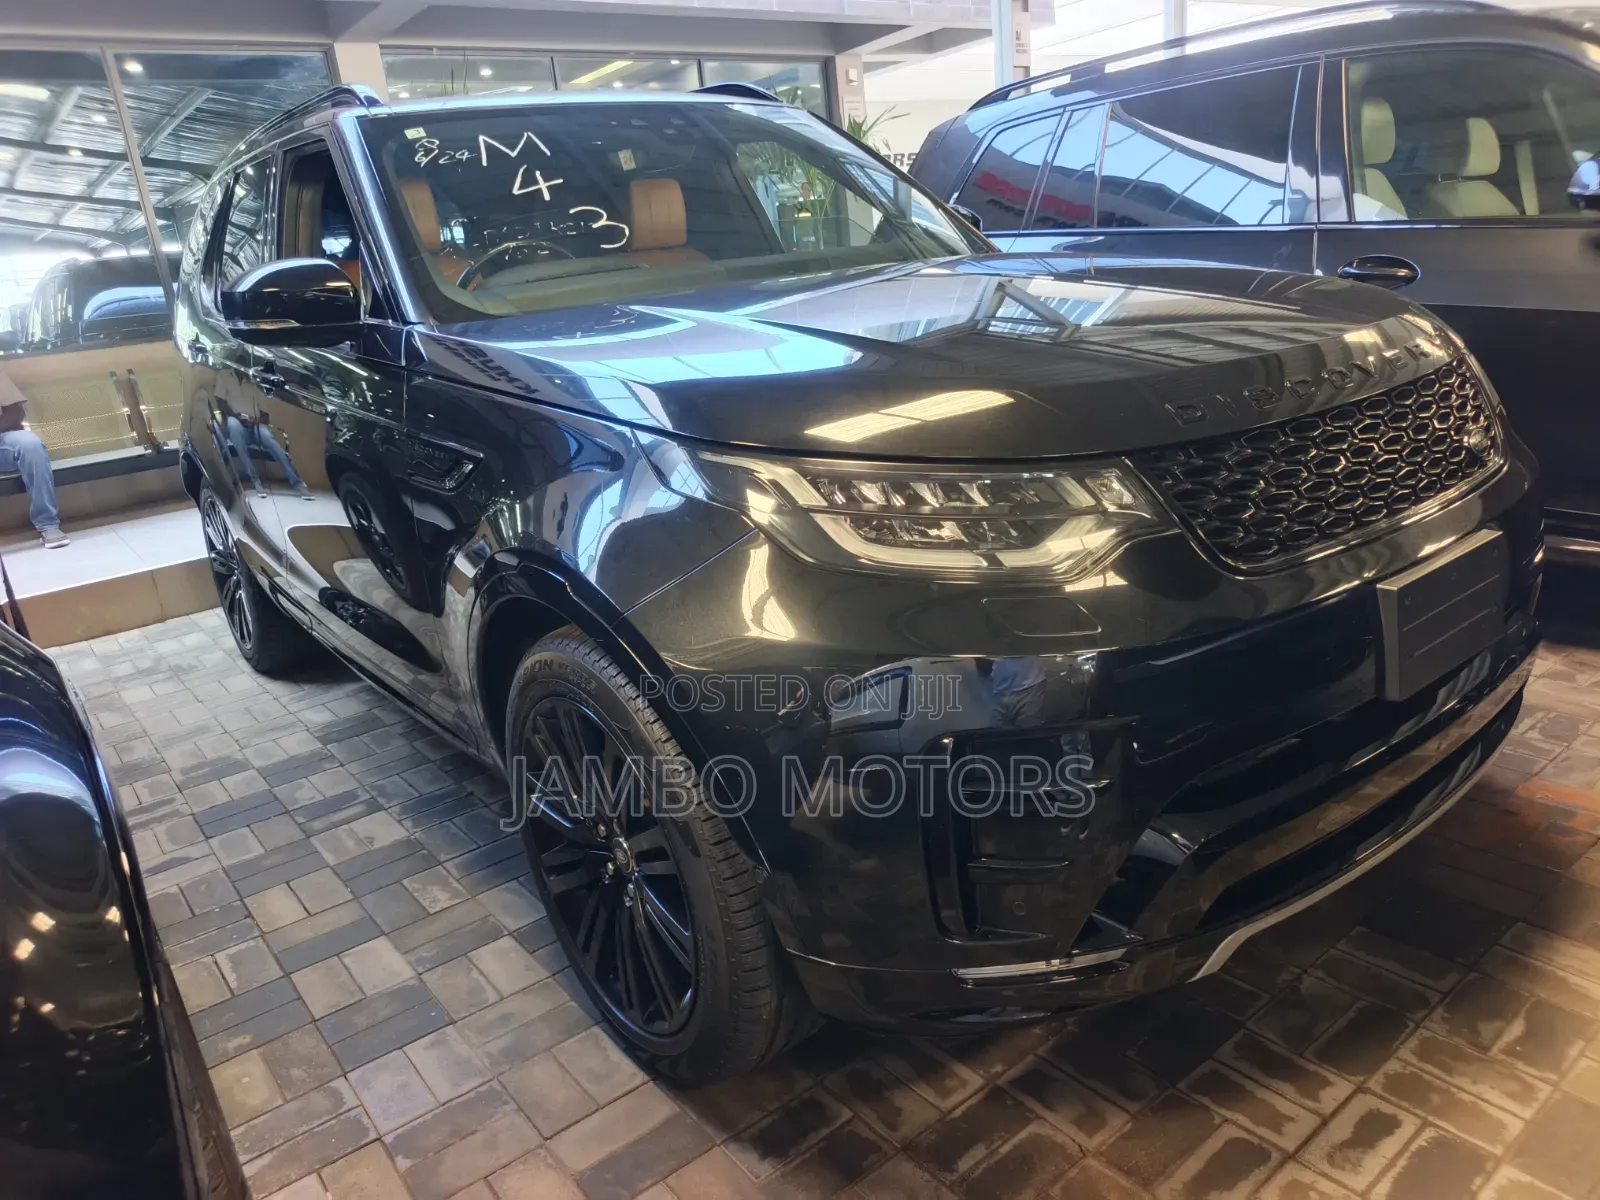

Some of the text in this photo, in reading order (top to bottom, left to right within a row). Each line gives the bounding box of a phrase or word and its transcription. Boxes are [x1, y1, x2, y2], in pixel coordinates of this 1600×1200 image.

[479, 132, 551, 166] M
[512, 164, 563, 201] 4
[569, 206, 630, 249] 3
[1165, 340, 1440, 427] DISCOVER
